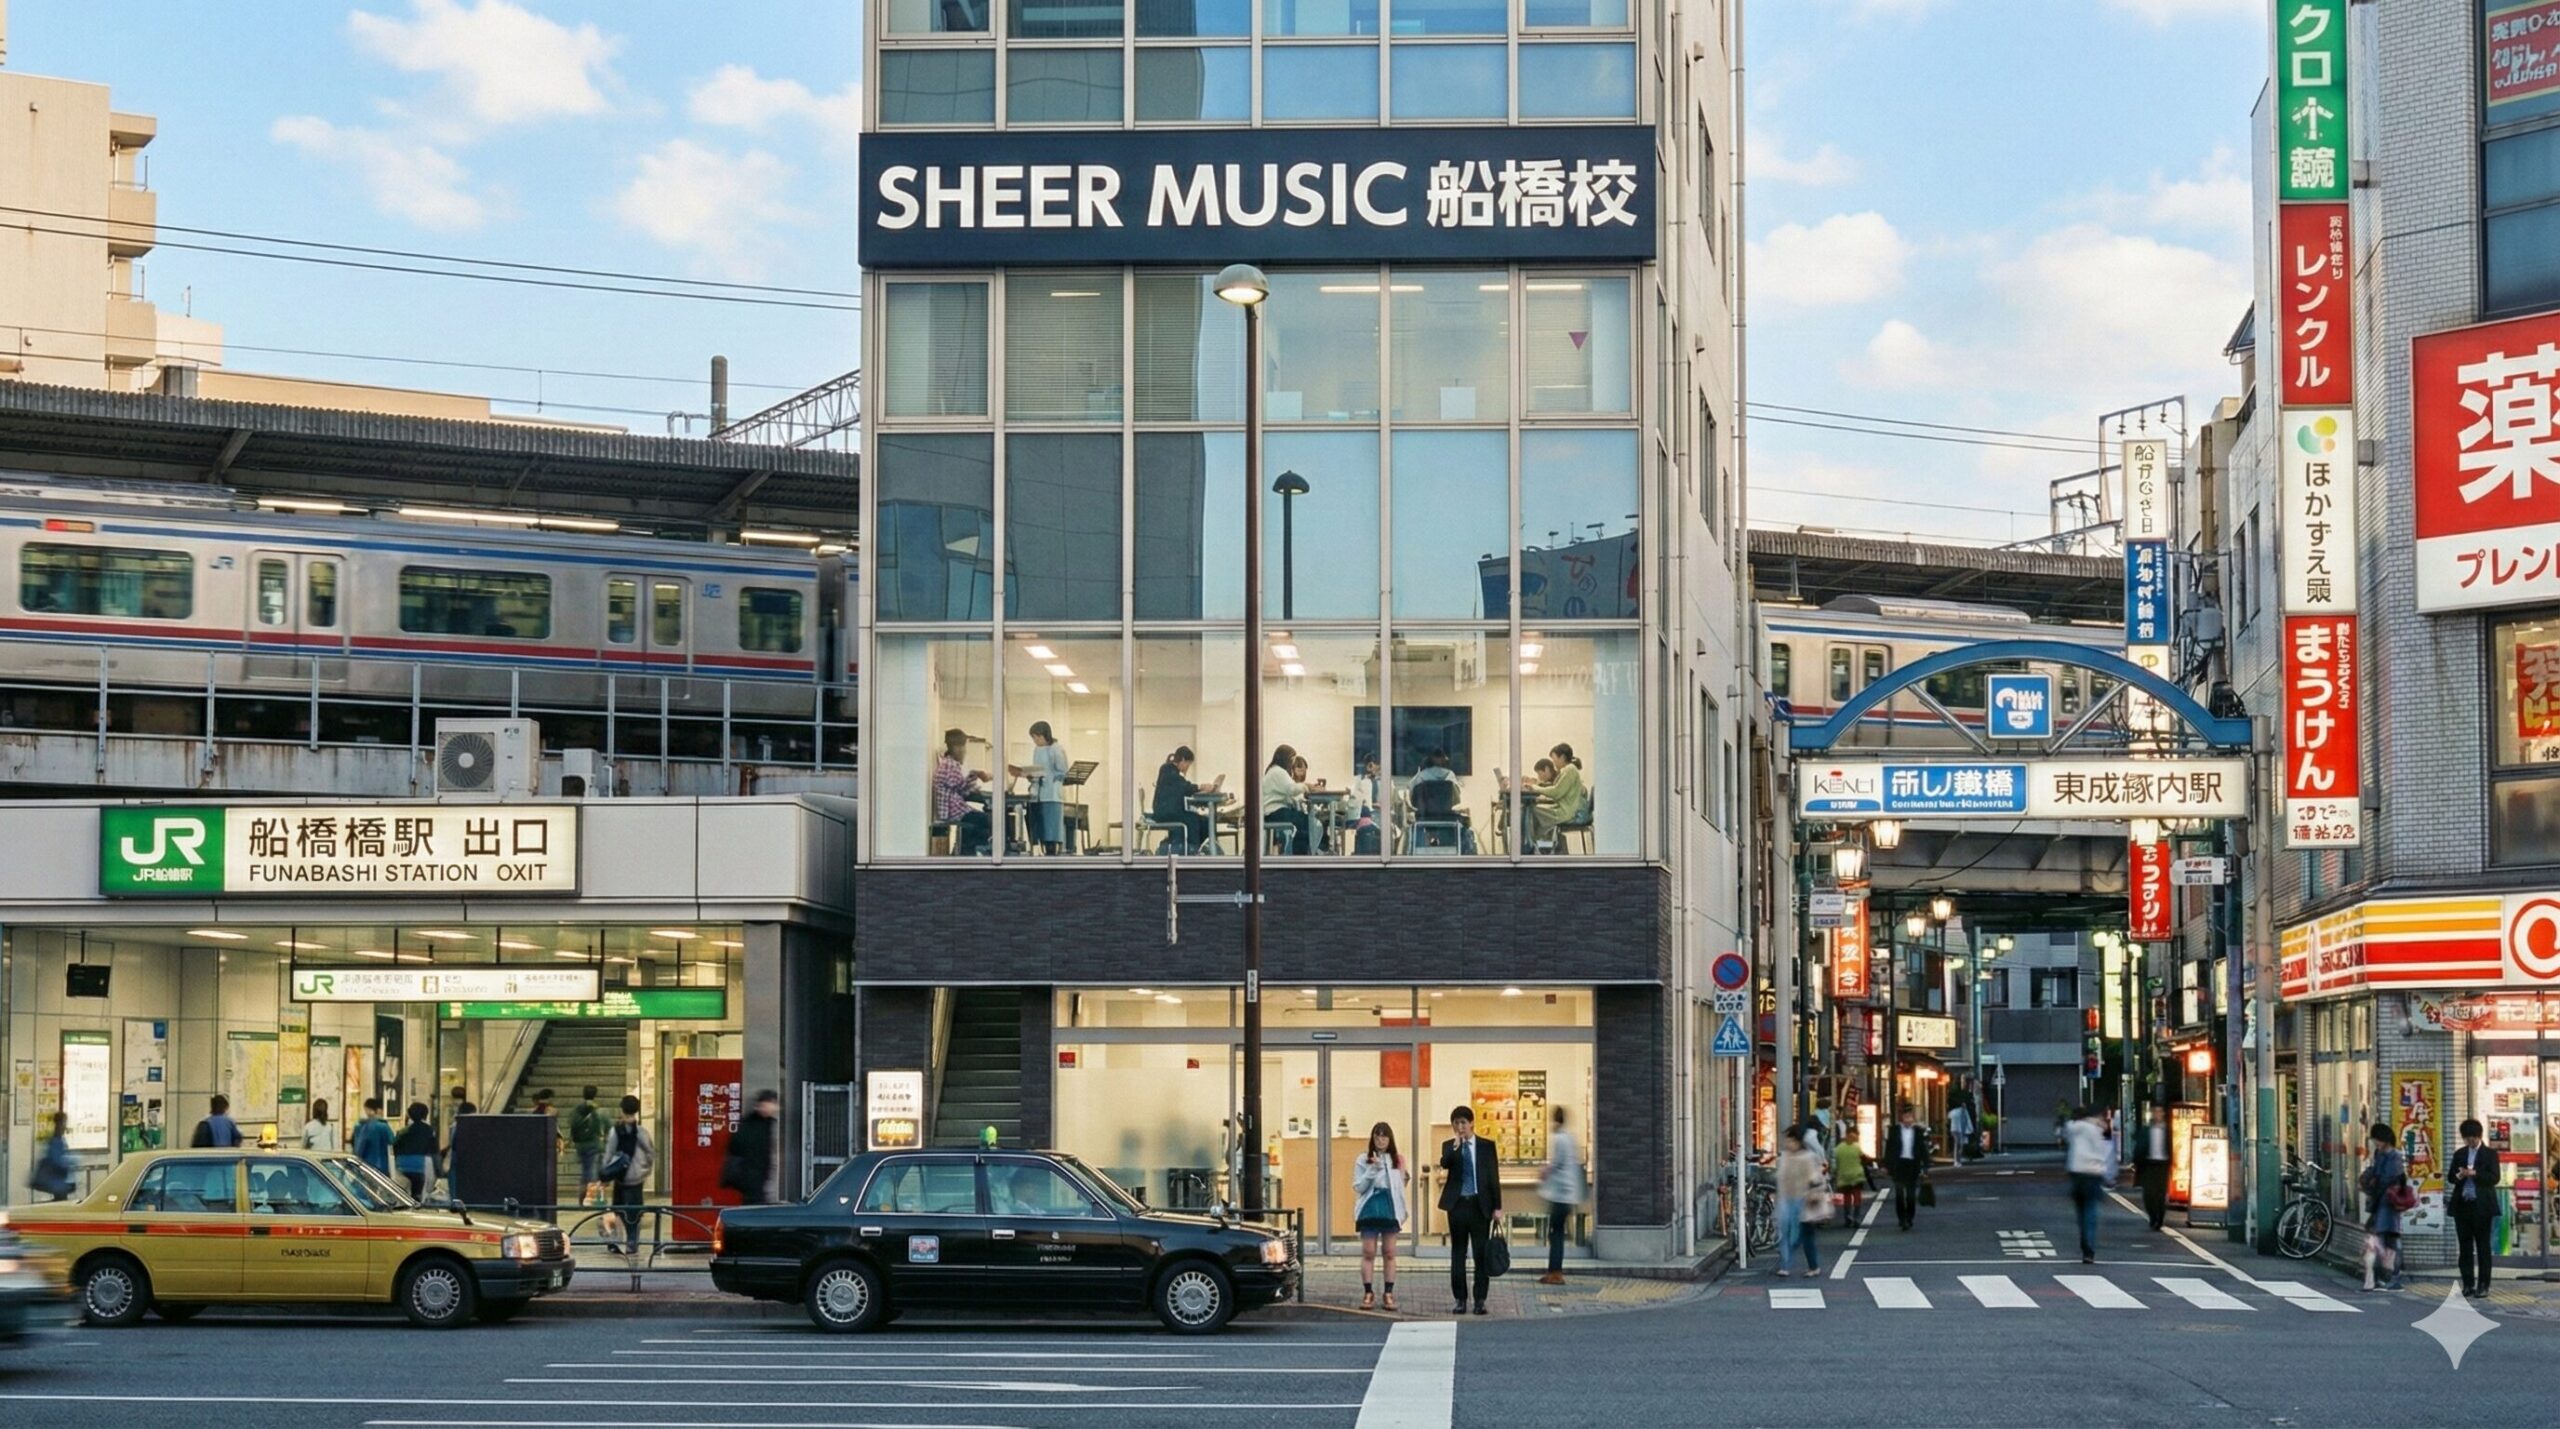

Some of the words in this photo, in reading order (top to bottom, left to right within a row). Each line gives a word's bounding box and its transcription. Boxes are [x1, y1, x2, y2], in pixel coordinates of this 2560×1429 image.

[876, 164, 1124, 229] SHEER
[1146, 161, 1408, 227] MUSIC
[1426, 158, 1639, 228] 船橋校
[2296, 245, 2331, 388] レンクル
[2457, 342, 2560, 504] 薬
[2457, 543, 2560, 589] プレン
[2295, 624, 2335, 790] まうけん
[120, 817, 206, 865] JR
[248, 816, 434, 858] 船橋橋駅
[463, 817, 548, 858] 出口
[249, 864, 378, 882] FUNABASHI
[385, 864, 478, 882] STATION
[496, 864, 548, 882] OXIT
[299, 974, 335, 994] JR
